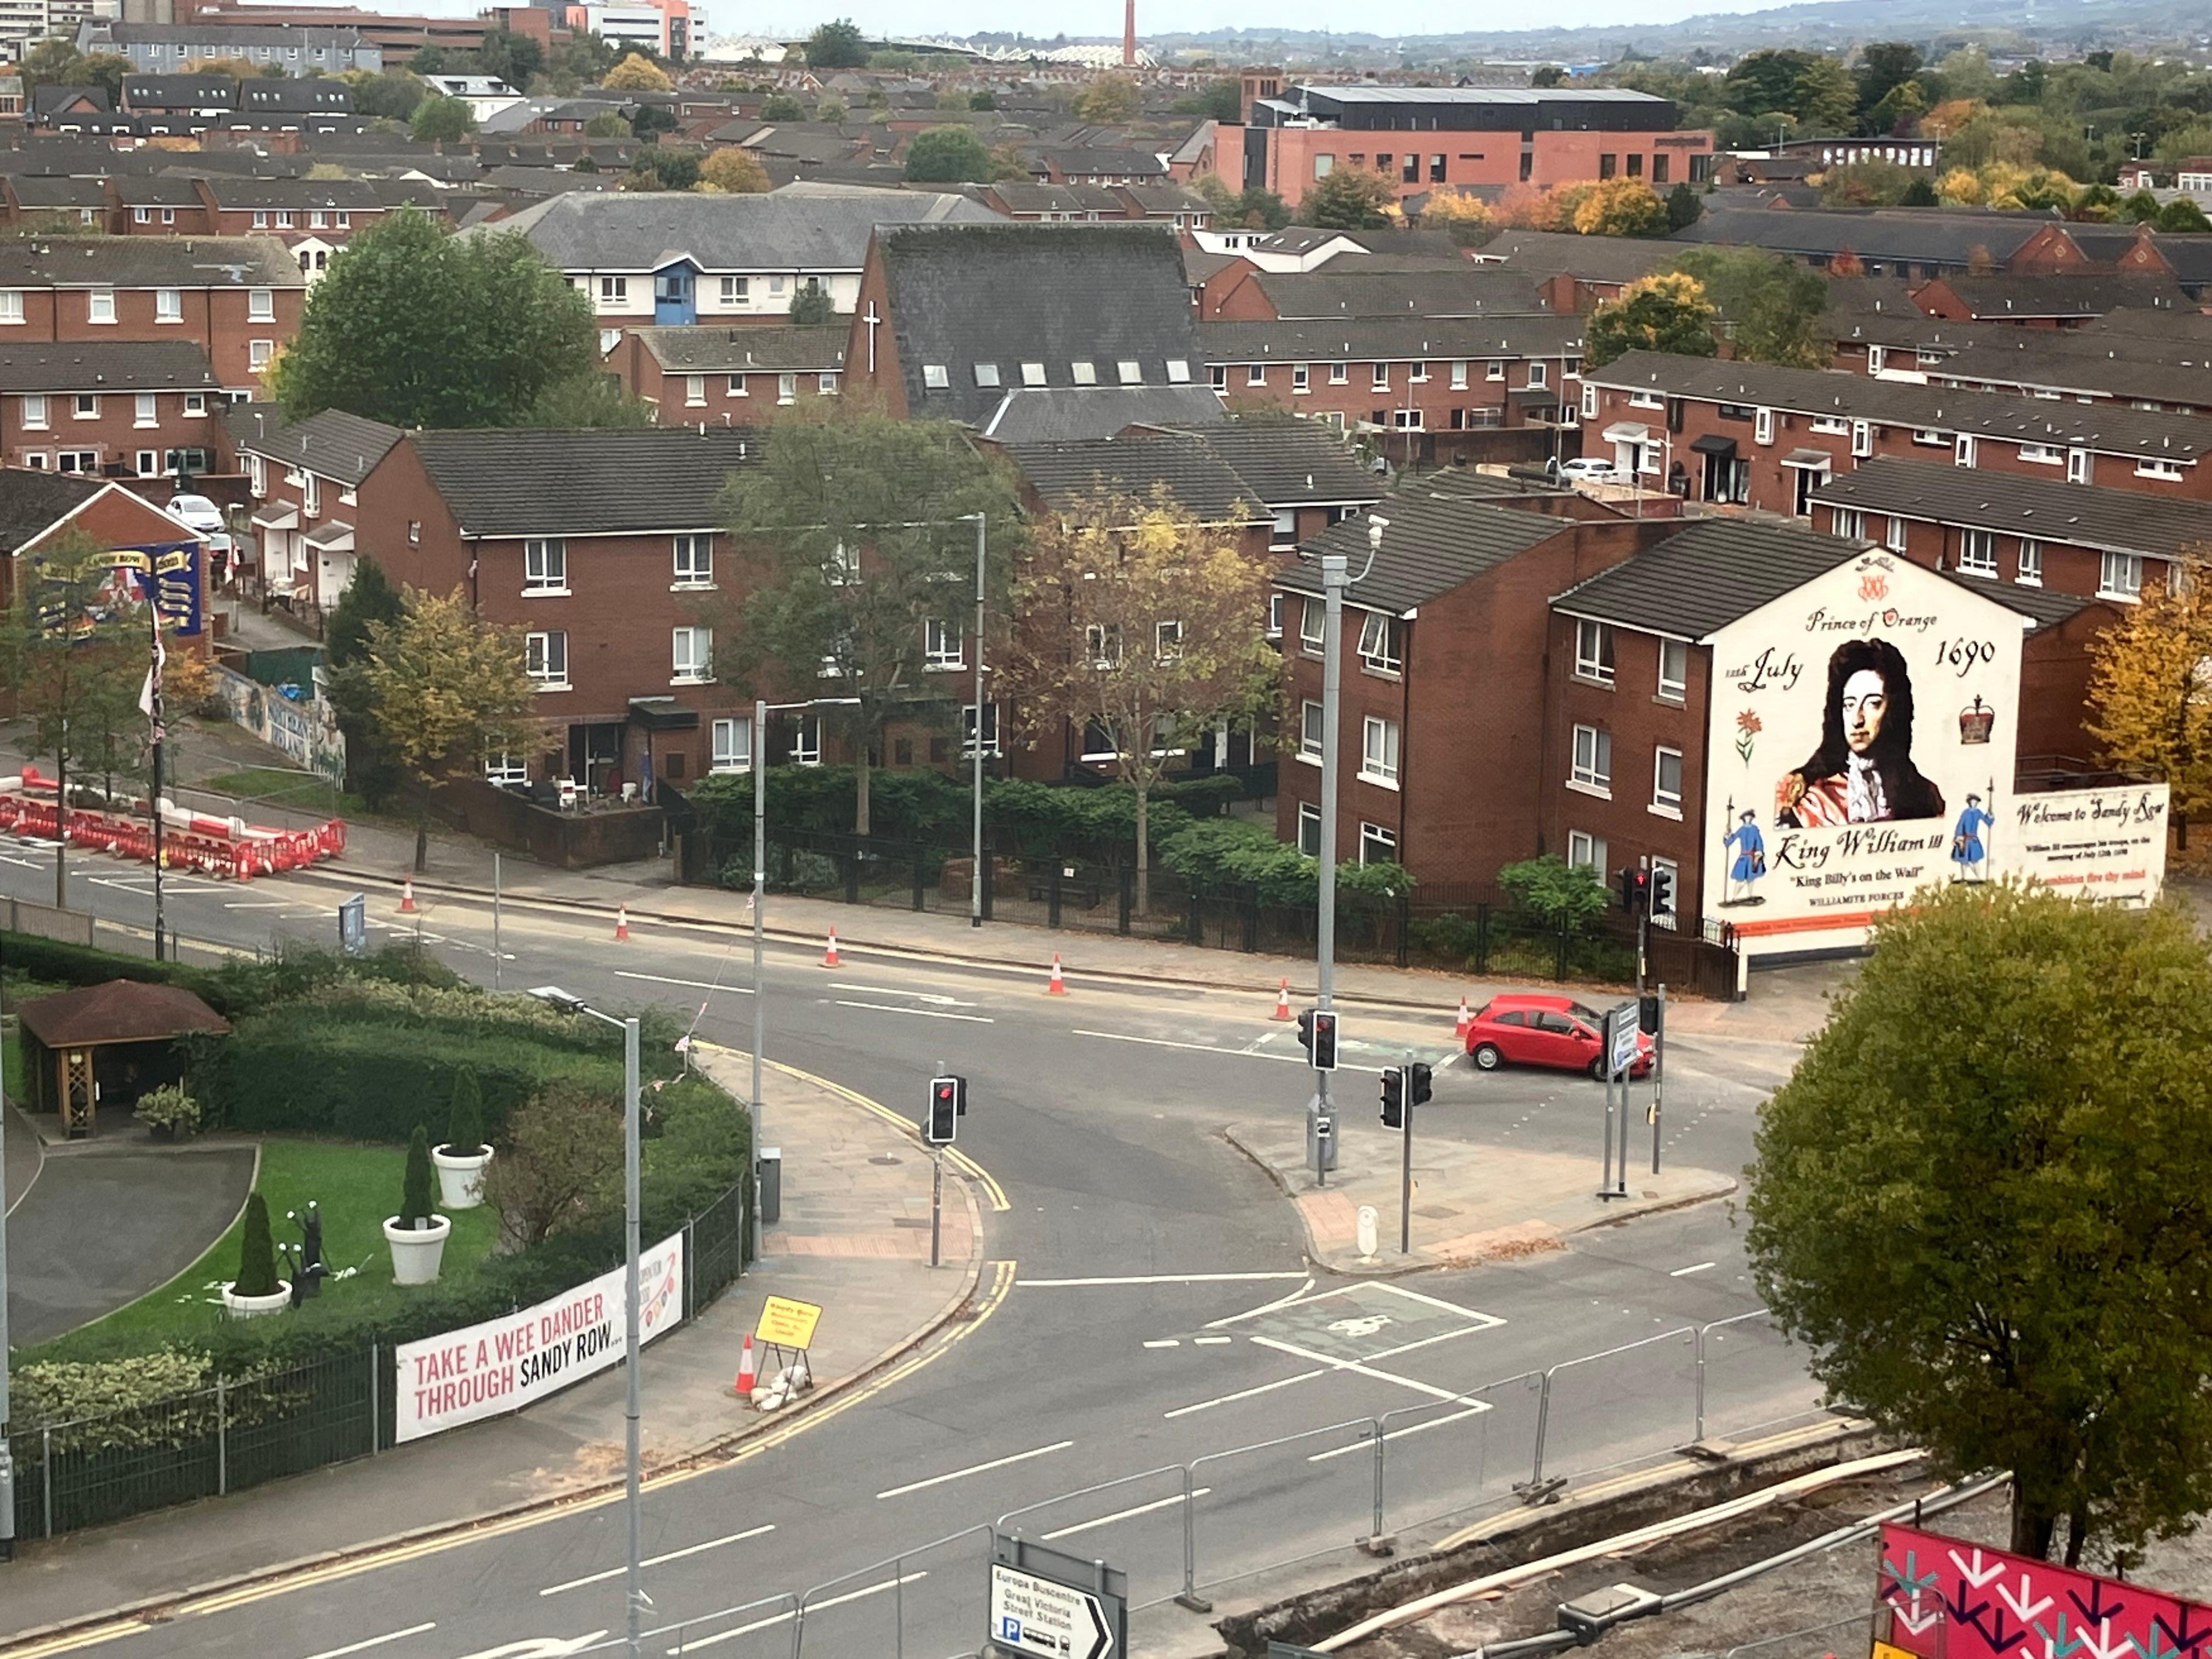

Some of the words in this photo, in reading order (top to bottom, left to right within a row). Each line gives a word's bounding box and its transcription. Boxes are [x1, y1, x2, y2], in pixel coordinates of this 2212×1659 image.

[1805, 607, 1856, 631] Prince
[1859, 612, 1878, 636] of
[1883, 608, 1937, 632] Orange
[1737, 647, 1803, 693] July
[1936, 637, 1995, 678] 1690
[2017, 803, 2072, 825] Welcome
[2074, 808, 2086, 820] to
[2090, 798, 2130, 827] Sandy
[2133, 792, 2164, 823] Row
[1772, 834, 1831, 870] King
[1836, 827, 1925, 857] William
[1927, 834, 1944, 849] III
[1860, 873, 1872, 882] on
[1876, 868, 1892, 881] the
[2086, 872, 2102, 883] fire
[2105, 871, 2119, 883] thy
[1809, 894, 1866, 906] WILLIAMITE
[1868, 891, 1905, 902] FORCES
[414, 1344, 469, 1386] TAKE
[475, 1339, 489, 1369] A
[494, 1322, 535, 1363] WEE
[541, 1293, 603, 1346] DANDER
[414, 1364, 514, 1420] THROUGH
[520, 1338, 572, 1387] SANDY
[996, 1570, 1030, 1589] Europa
[1033, 1582, 1081, 1606] Buscentre
[1005, 1588, 1031, 1607] Great
[1035, 1597, 1071, 1618] Victoria
[1003, 1600, 1034, 1618] Street
[1037, 1611, 1072, 1630] Station
